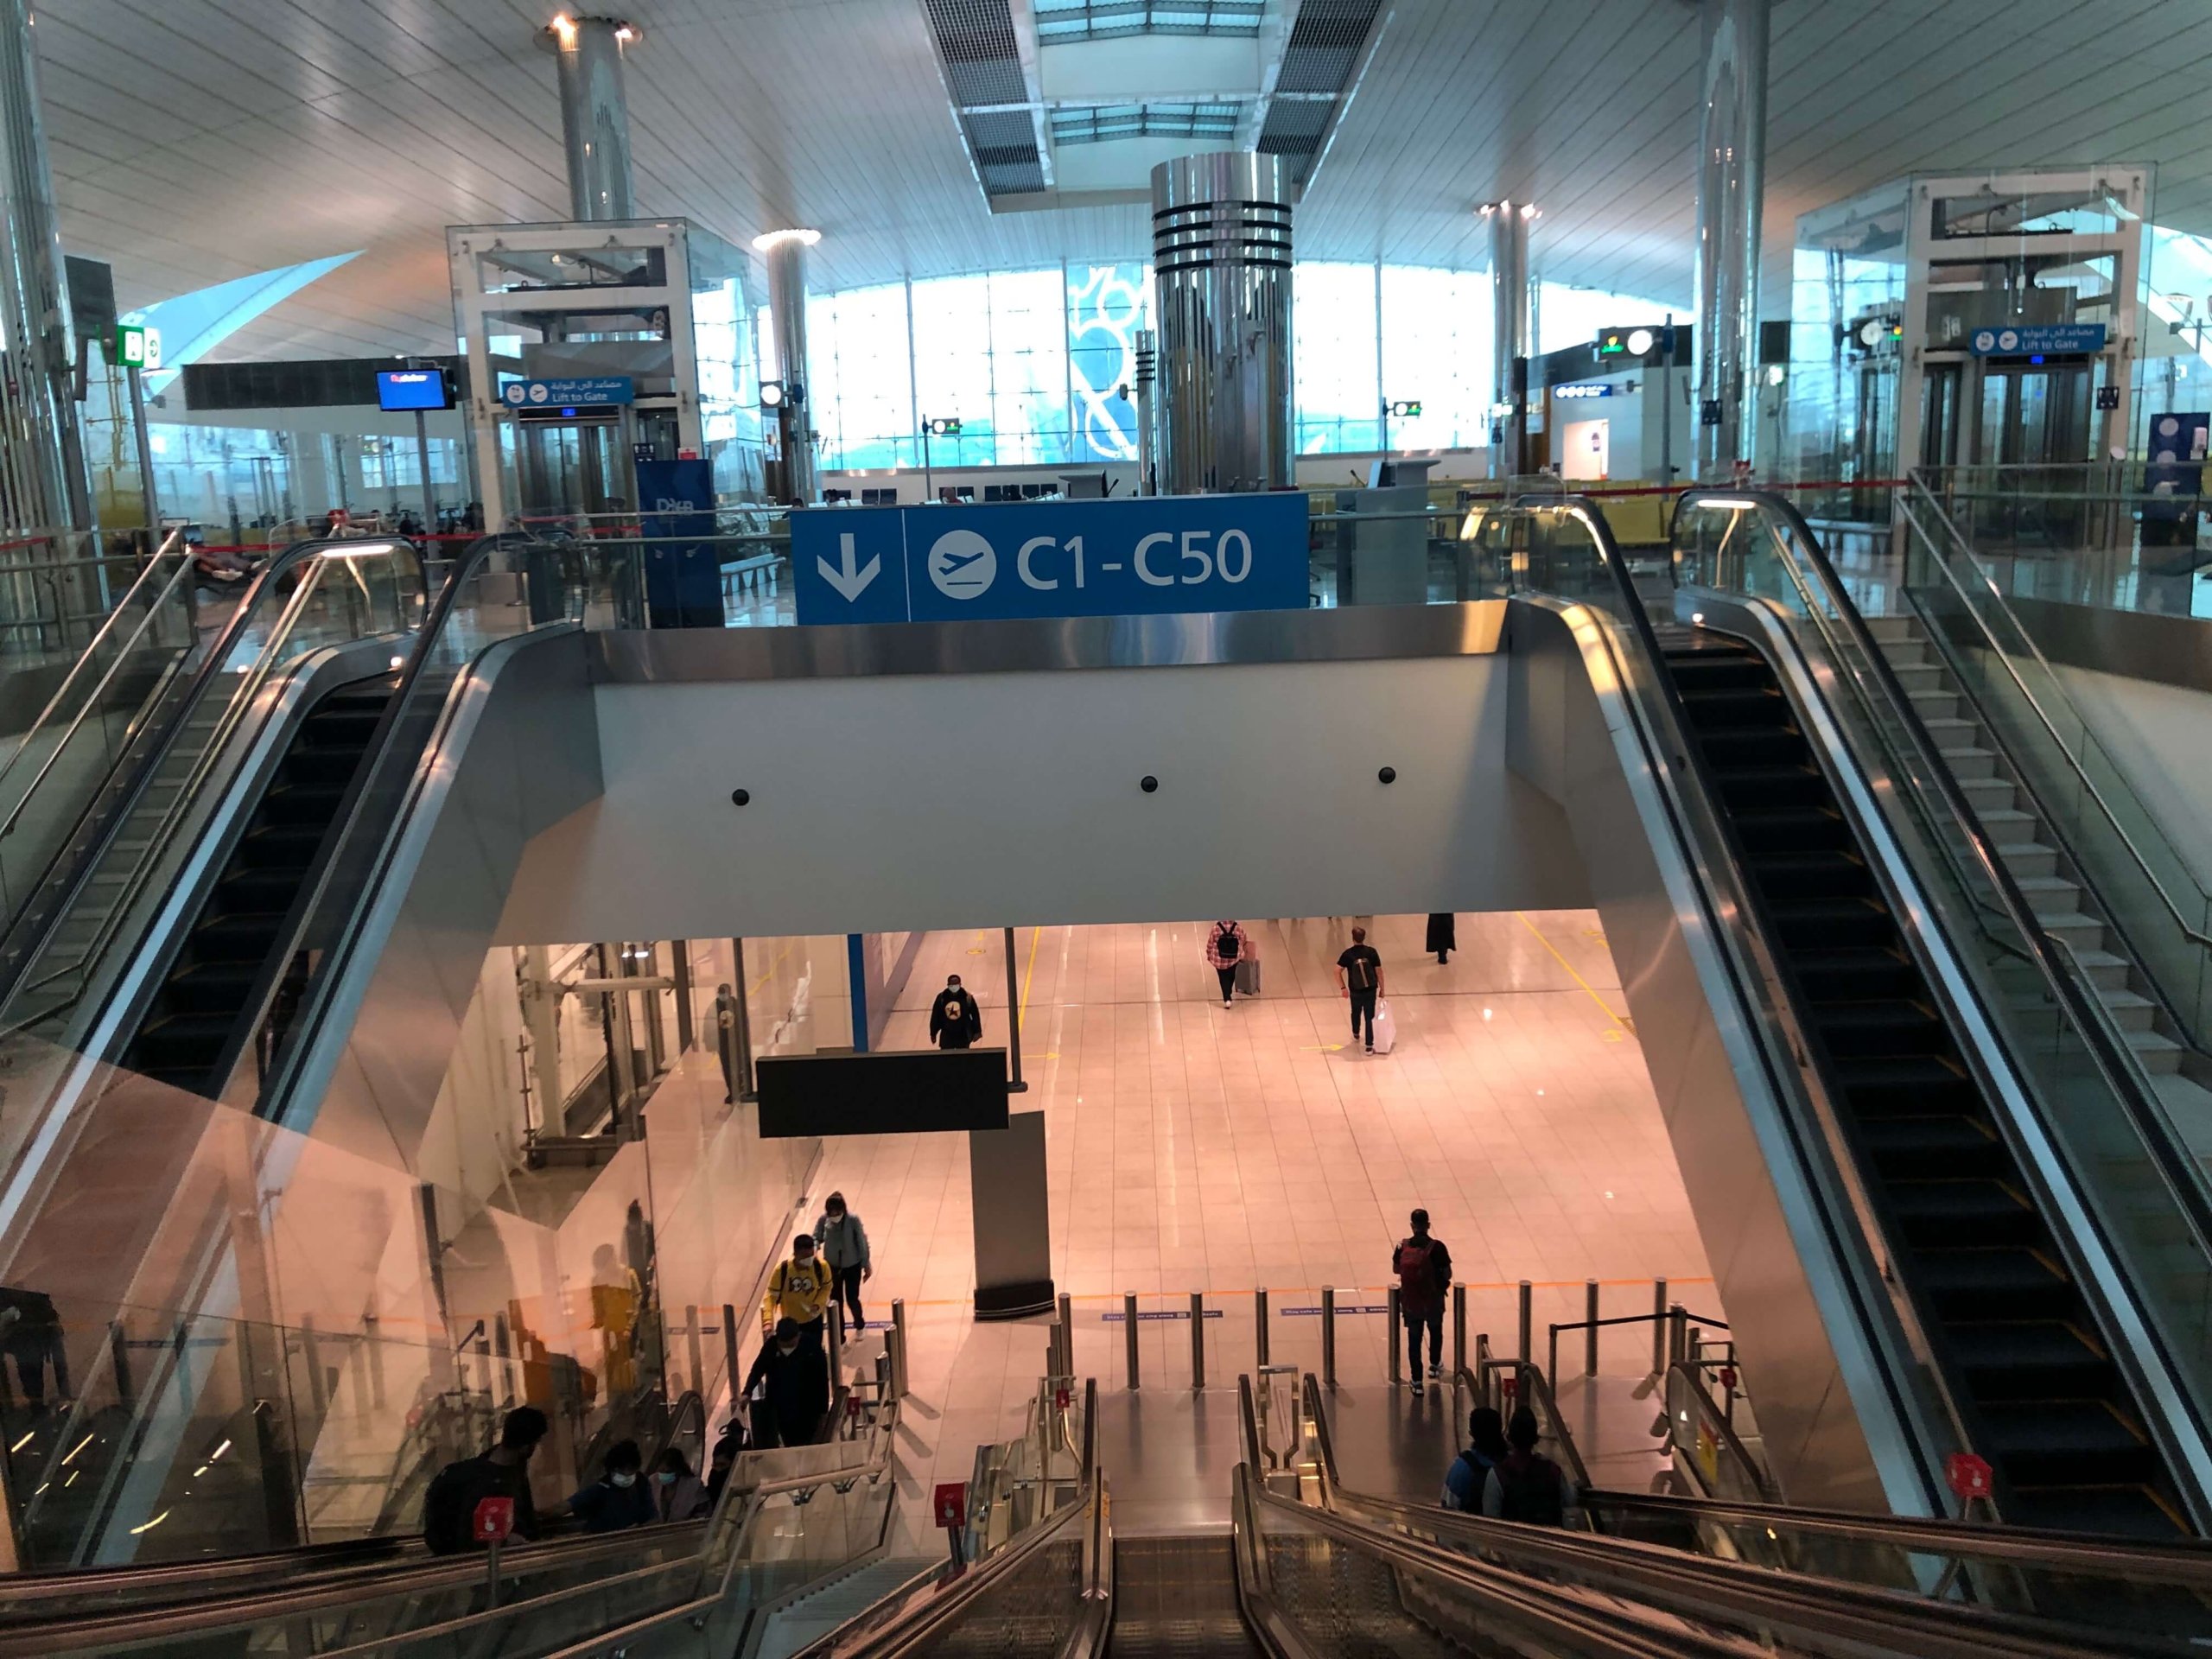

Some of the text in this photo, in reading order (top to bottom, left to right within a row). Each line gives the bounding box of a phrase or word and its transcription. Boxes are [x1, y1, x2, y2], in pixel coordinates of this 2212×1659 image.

[2022, 339, 2079, 350] Lift to Gate
[552, 391, 608, 403] Lift to Gate
[1017, 536, 1084, 590] C1
[1134, 529, 1252, 586] C50
